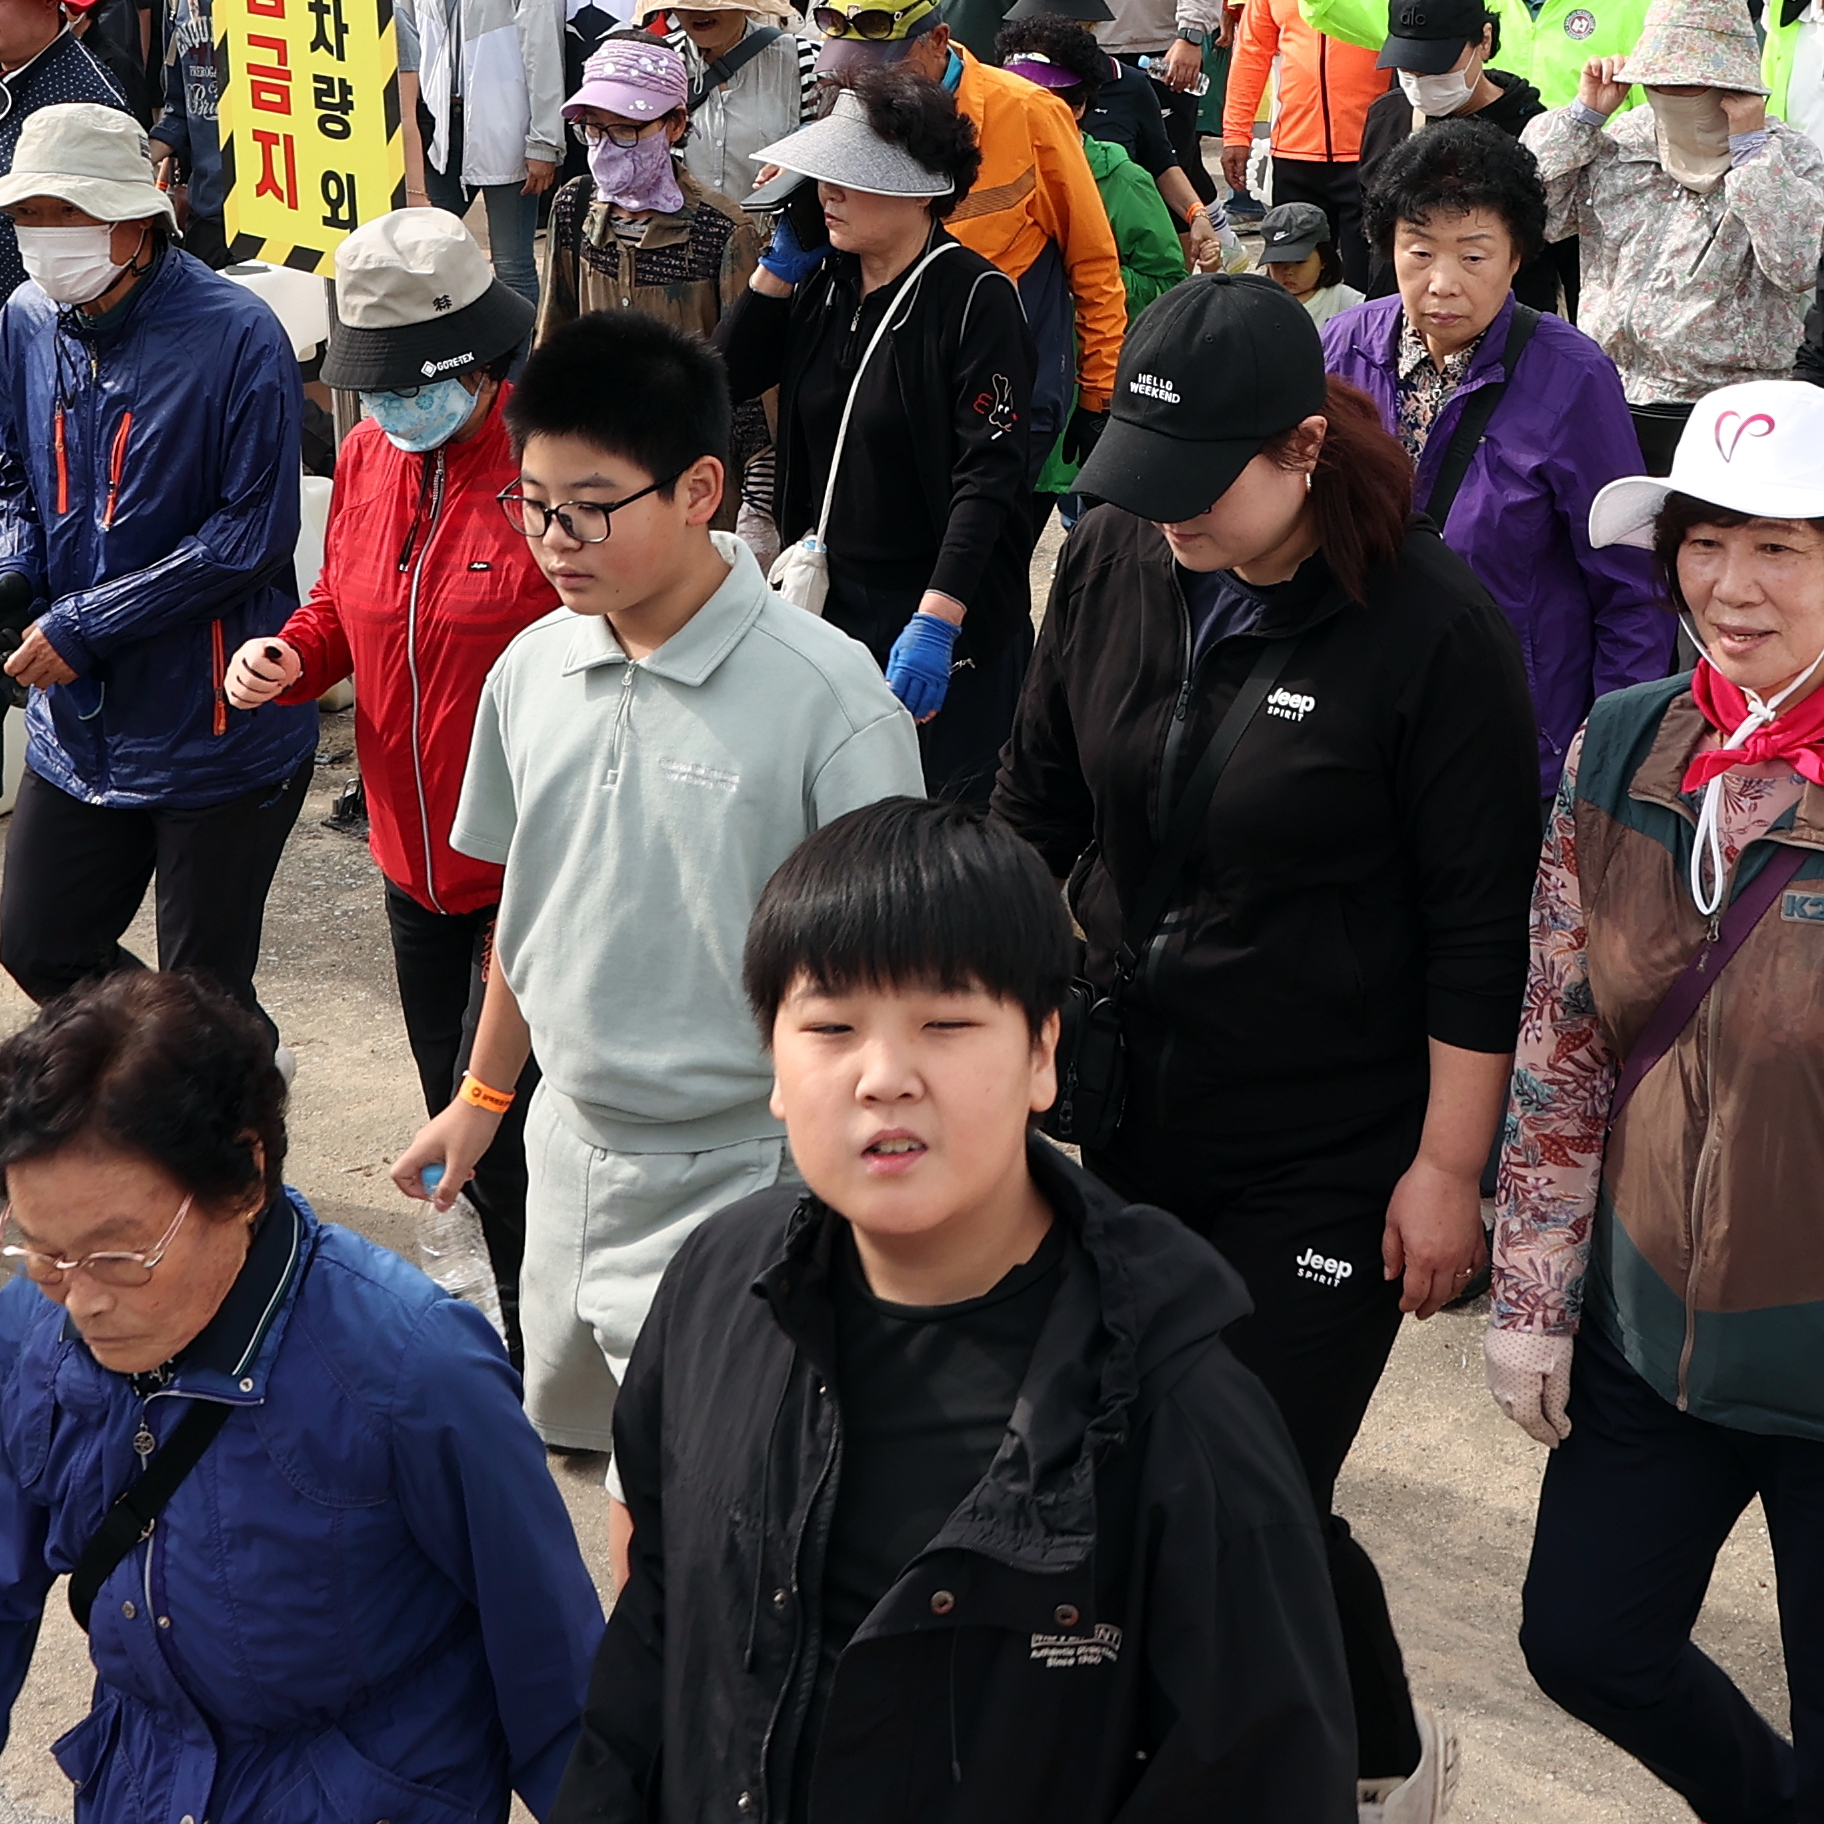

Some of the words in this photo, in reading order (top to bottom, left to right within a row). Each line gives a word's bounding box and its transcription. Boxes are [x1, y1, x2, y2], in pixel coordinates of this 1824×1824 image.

[1400, 6, 1426, 26] alo
[320, 169, 359, 231] 외
[1129, 381, 1181, 404] WEEKEND
[1138, 372, 1174, 391] HELLO
[1267, 687, 1316, 713] Jeep
[1267, 706, 1304, 722] SPIRIT
[1296, 1248, 1353, 1280] Jeep
[1297, 1268, 1341, 1289] SPIRIT
